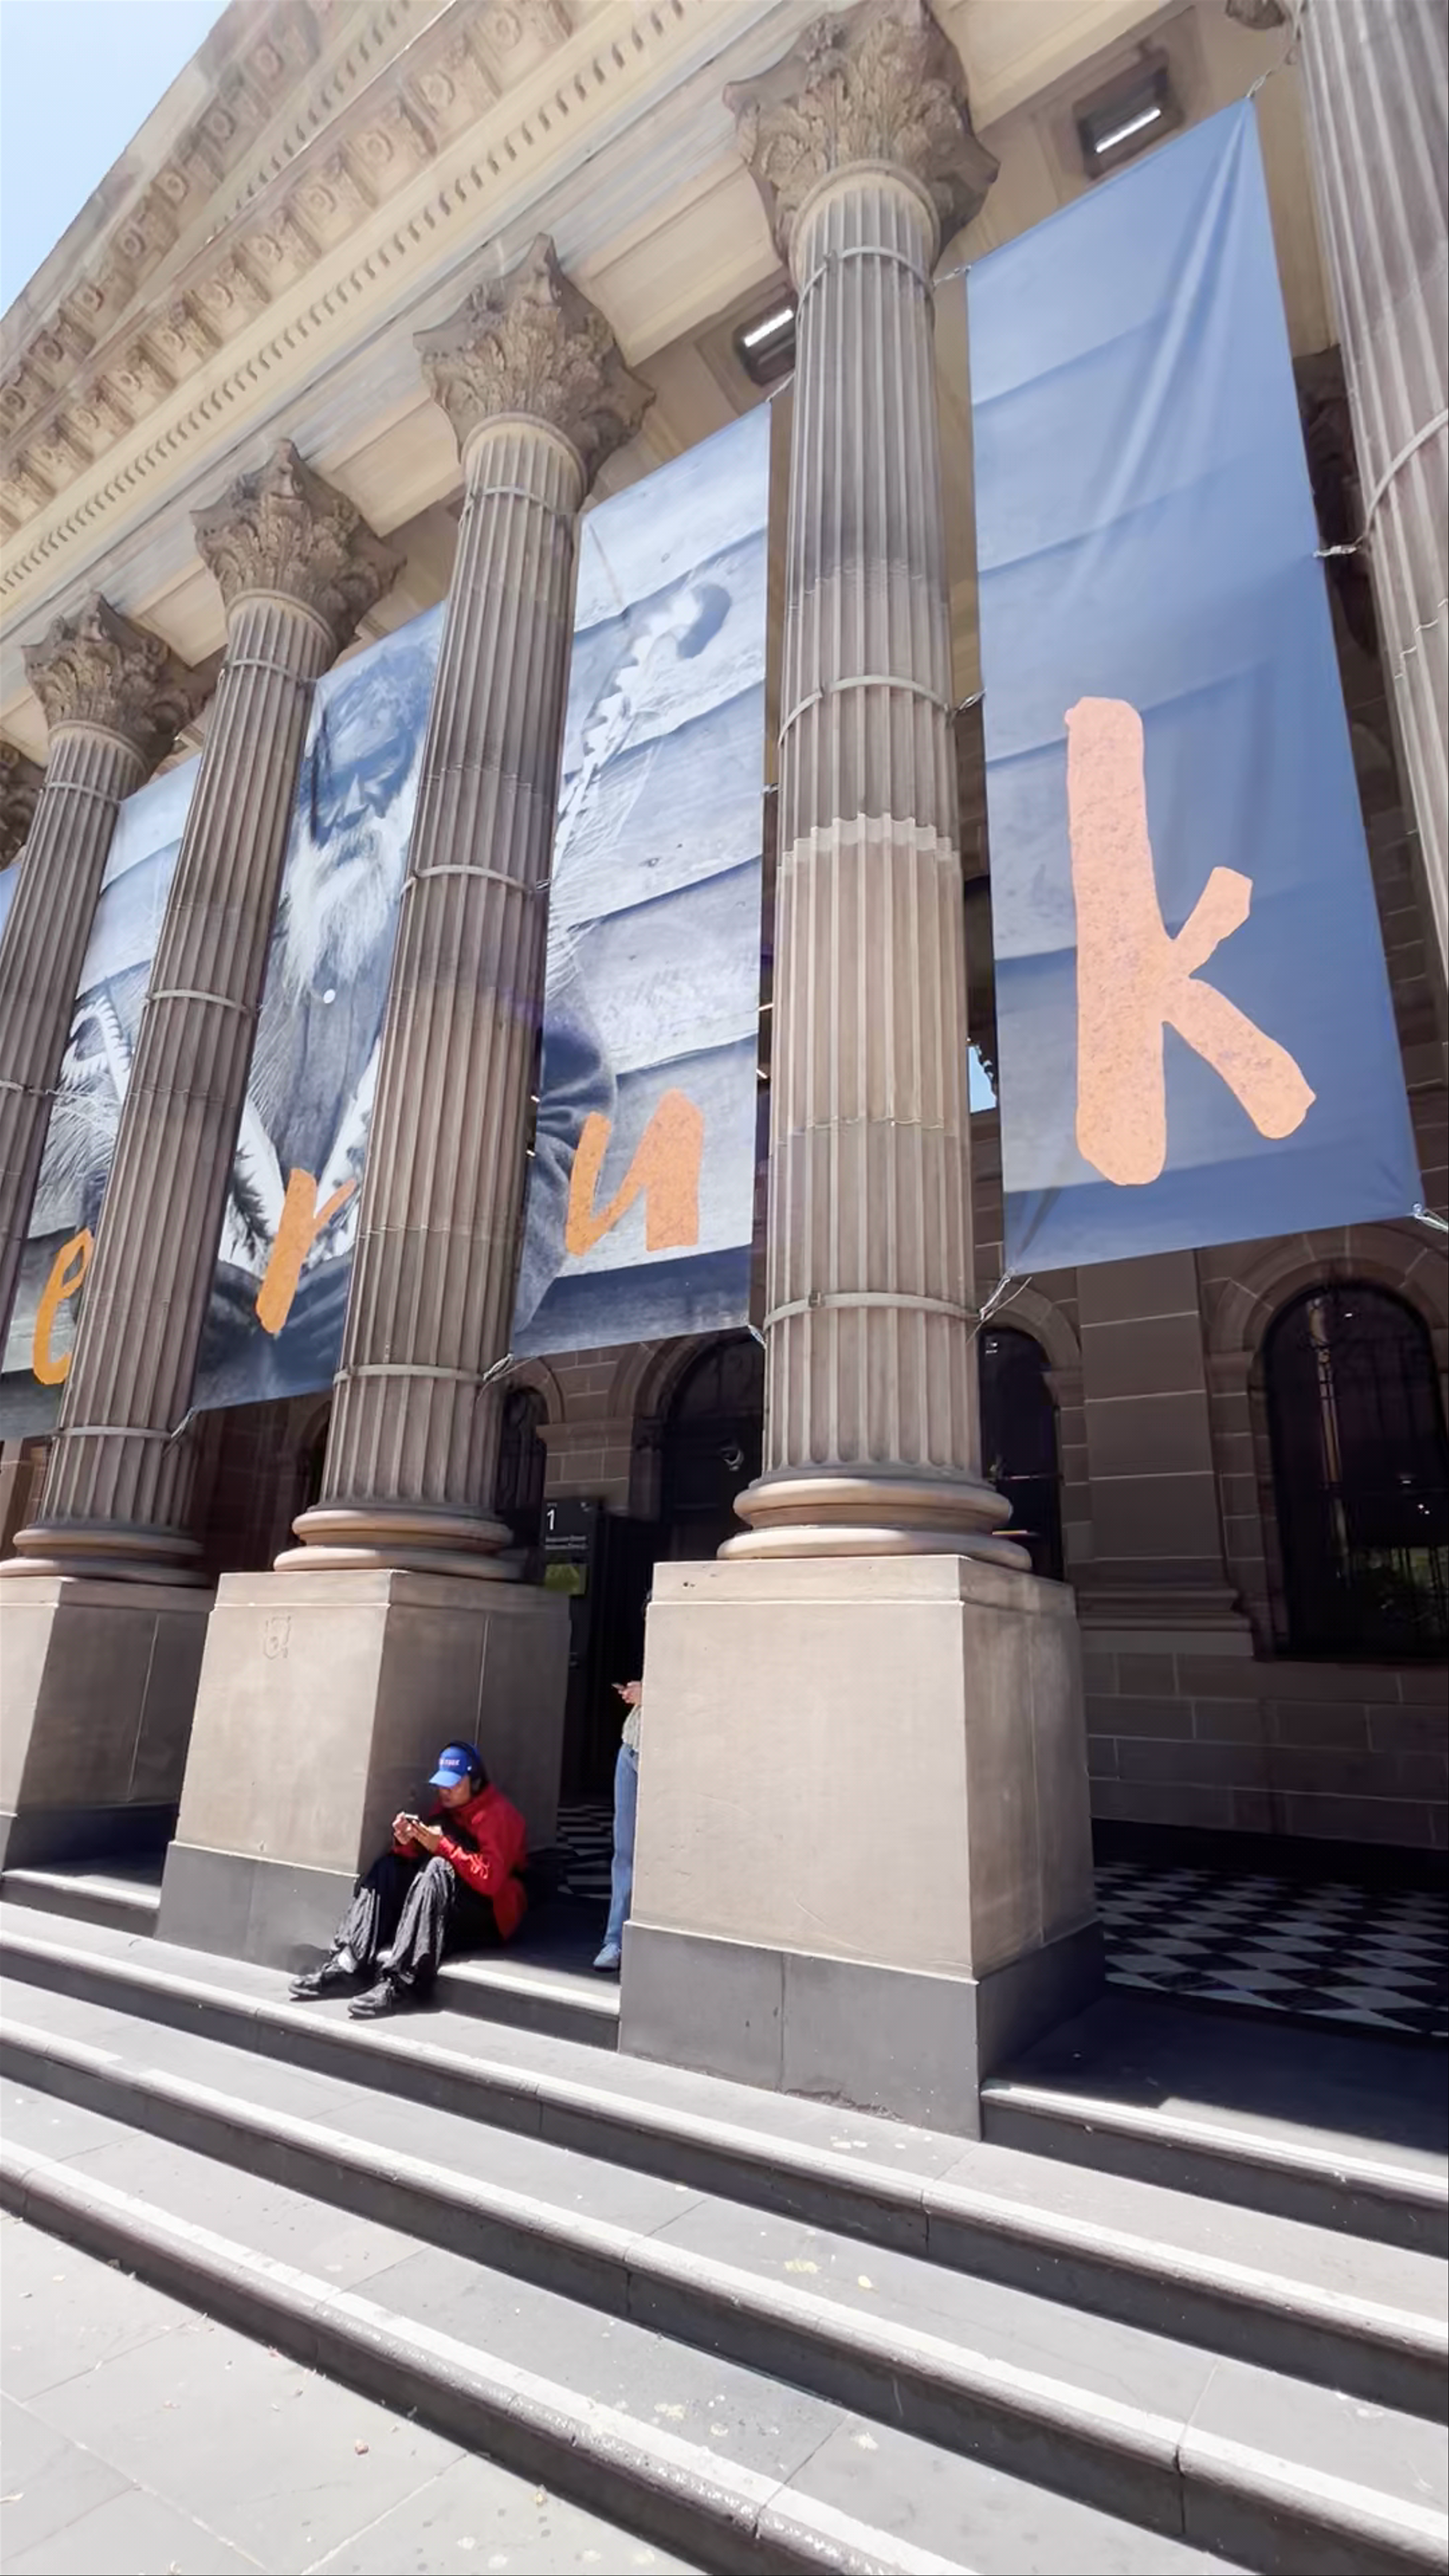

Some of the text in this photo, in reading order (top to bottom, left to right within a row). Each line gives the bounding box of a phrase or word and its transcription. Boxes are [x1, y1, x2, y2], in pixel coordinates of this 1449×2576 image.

[1064, 697, 1316, 1185] k
[256, 1169, 356, 1334] r
[547, 1509, 555, 1530] 1
